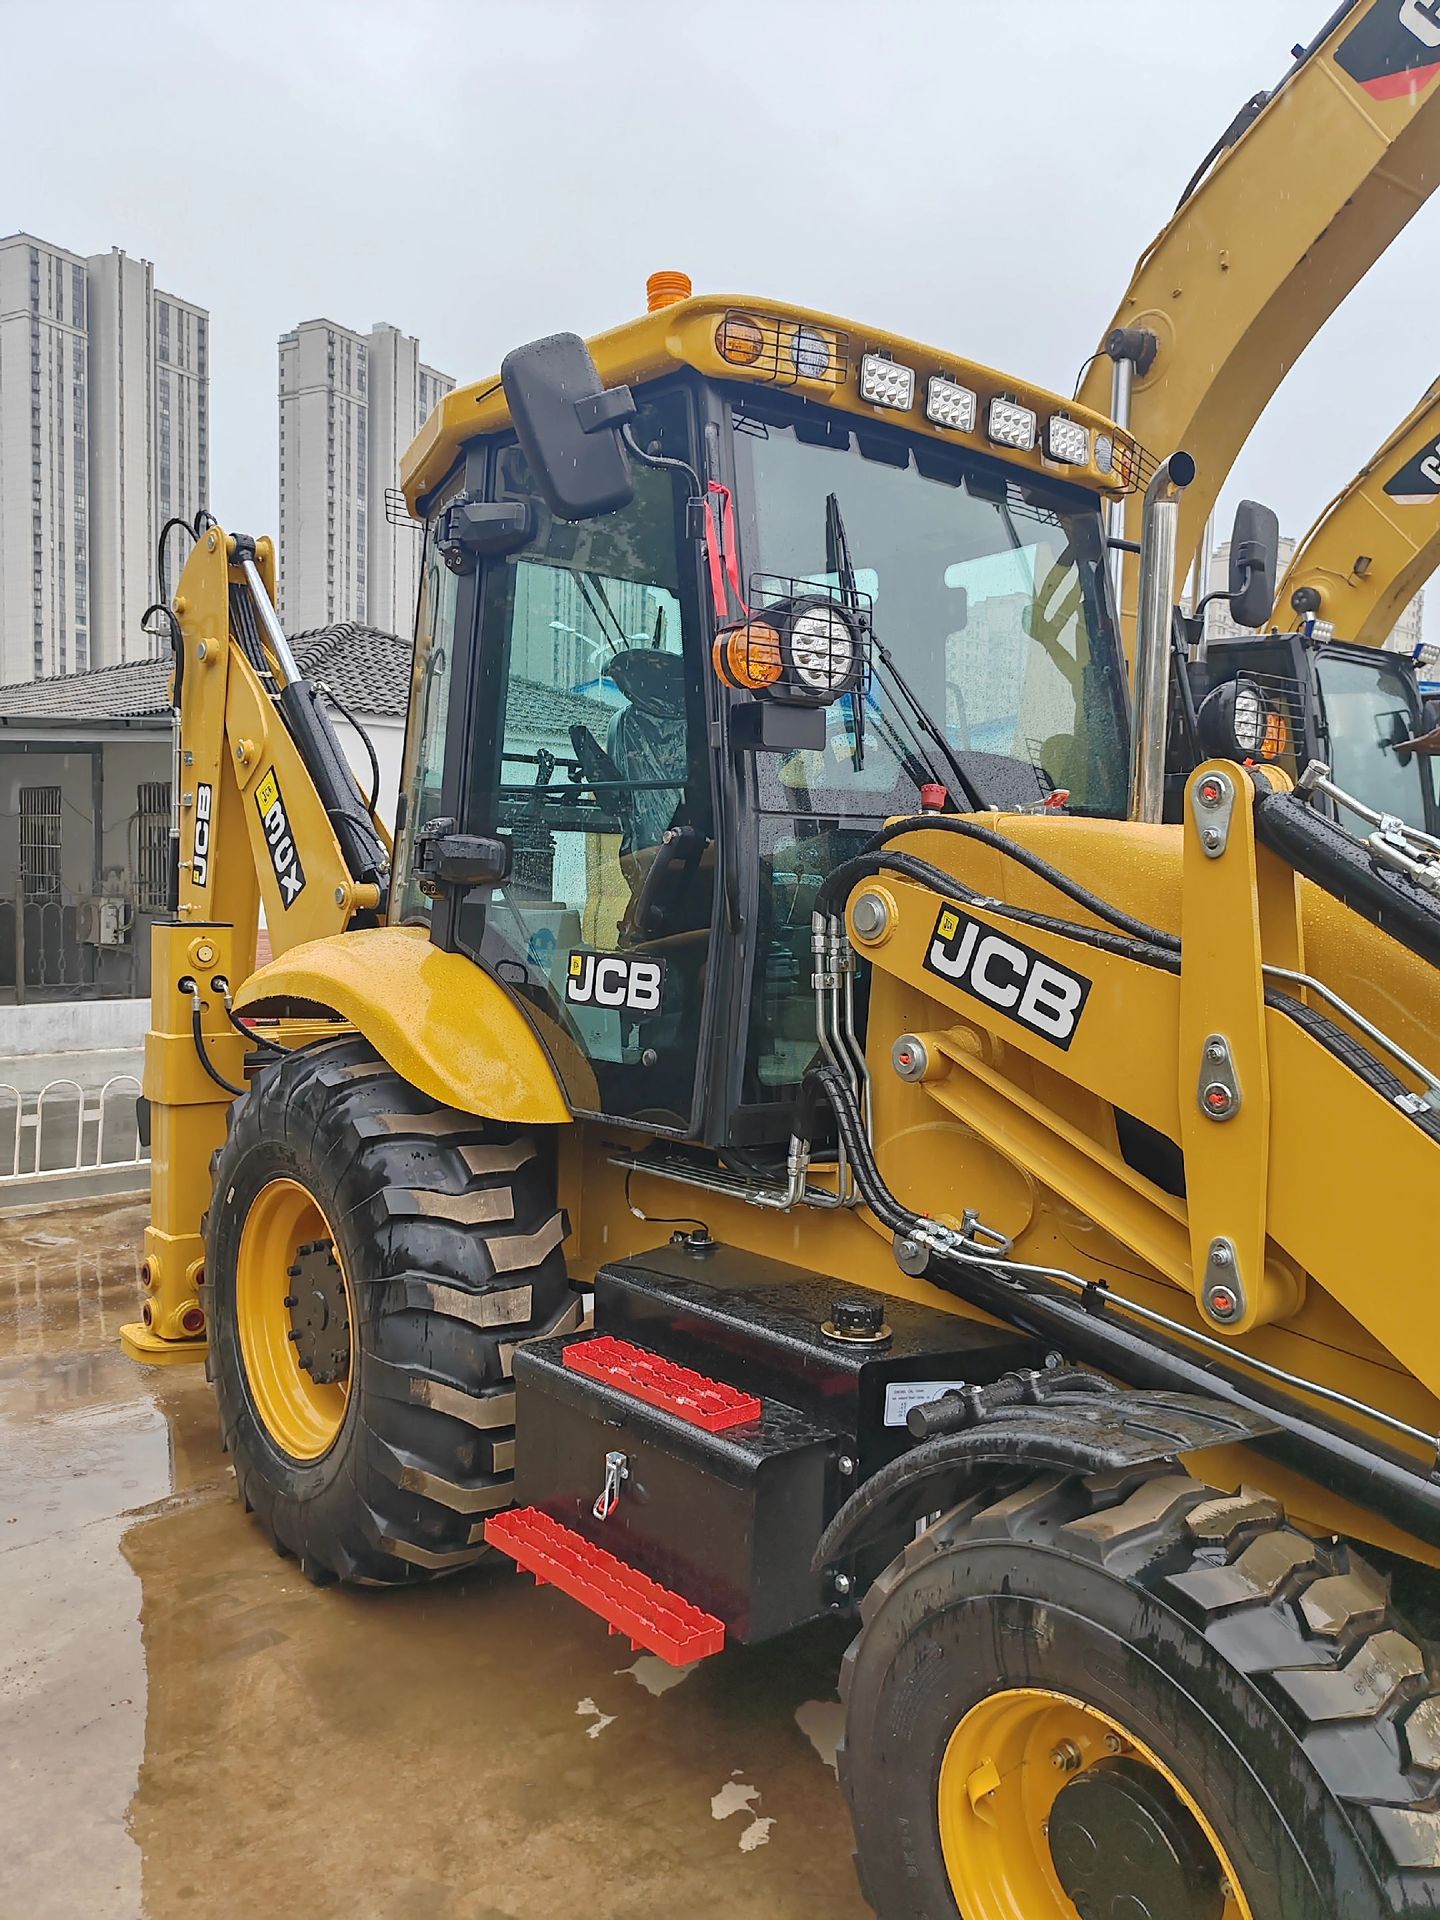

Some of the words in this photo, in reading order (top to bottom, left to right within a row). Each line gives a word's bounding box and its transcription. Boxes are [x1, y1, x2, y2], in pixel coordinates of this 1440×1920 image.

[193, 785, 212, 885] JCB
[265, 801, 302, 904] 3CX
[568, 955, 661, 1010] JCB
[930, 921, 1082, 1039] JCB
